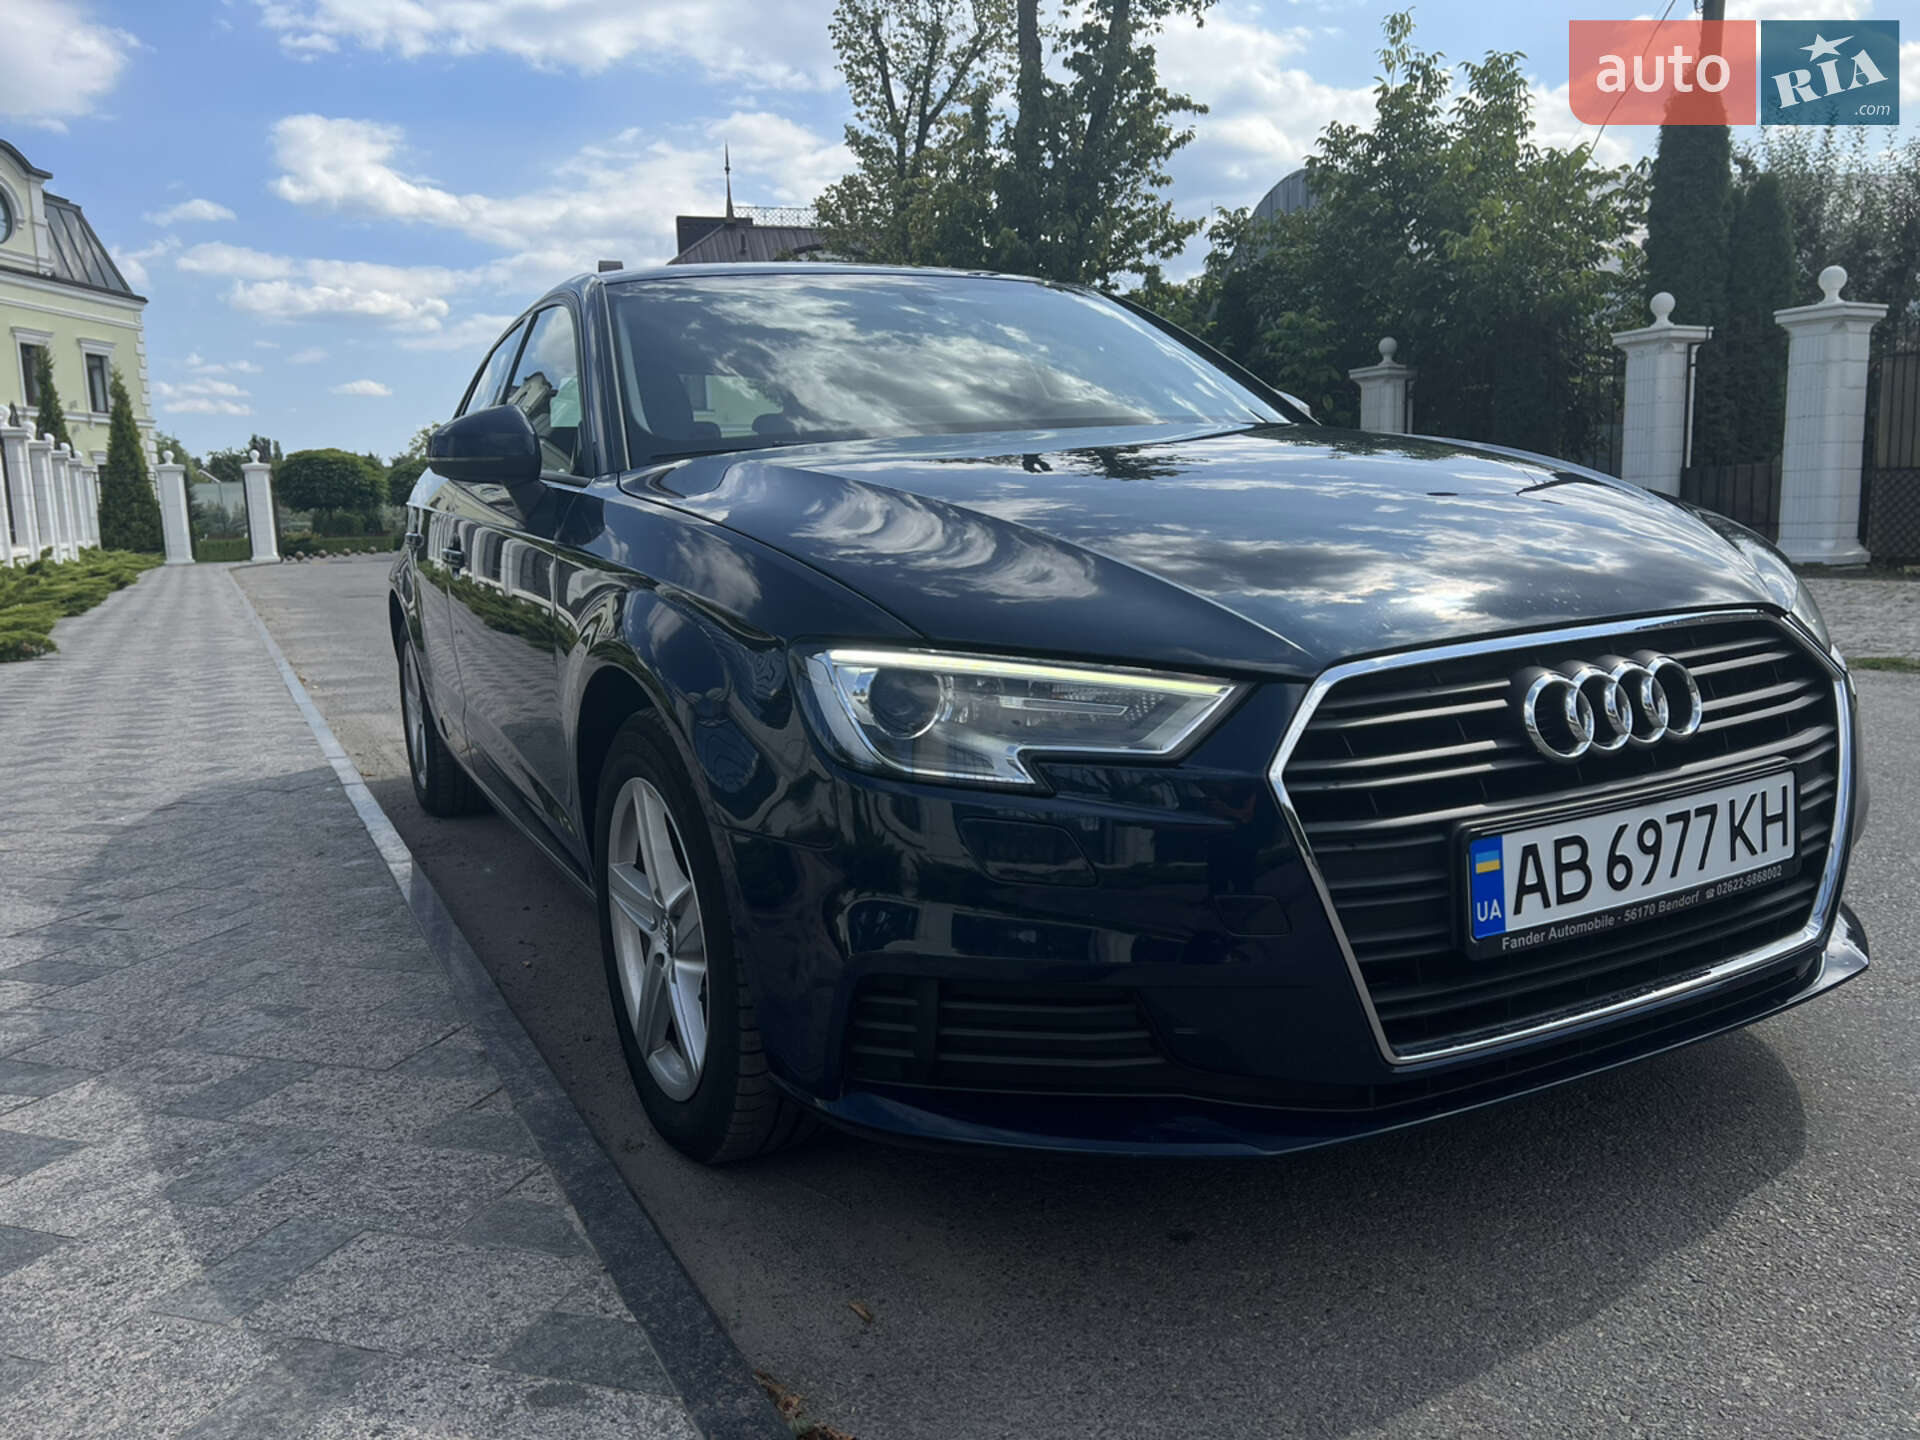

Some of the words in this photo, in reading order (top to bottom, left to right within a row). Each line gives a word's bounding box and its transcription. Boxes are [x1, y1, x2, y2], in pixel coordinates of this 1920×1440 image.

[1513, 834, 1593, 915] AB
[1606, 803, 1718, 892] 6977
[1729, 785, 1788, 862] KH
[1476, 899, 1502, 922] UA
[1502, 931, 1545, 951] Fander
[1548, 914, 1614, 940] Automobile
[1623, 904, 1655, 922] 56170
[1658, 890, 1700, 913] Bendorf
